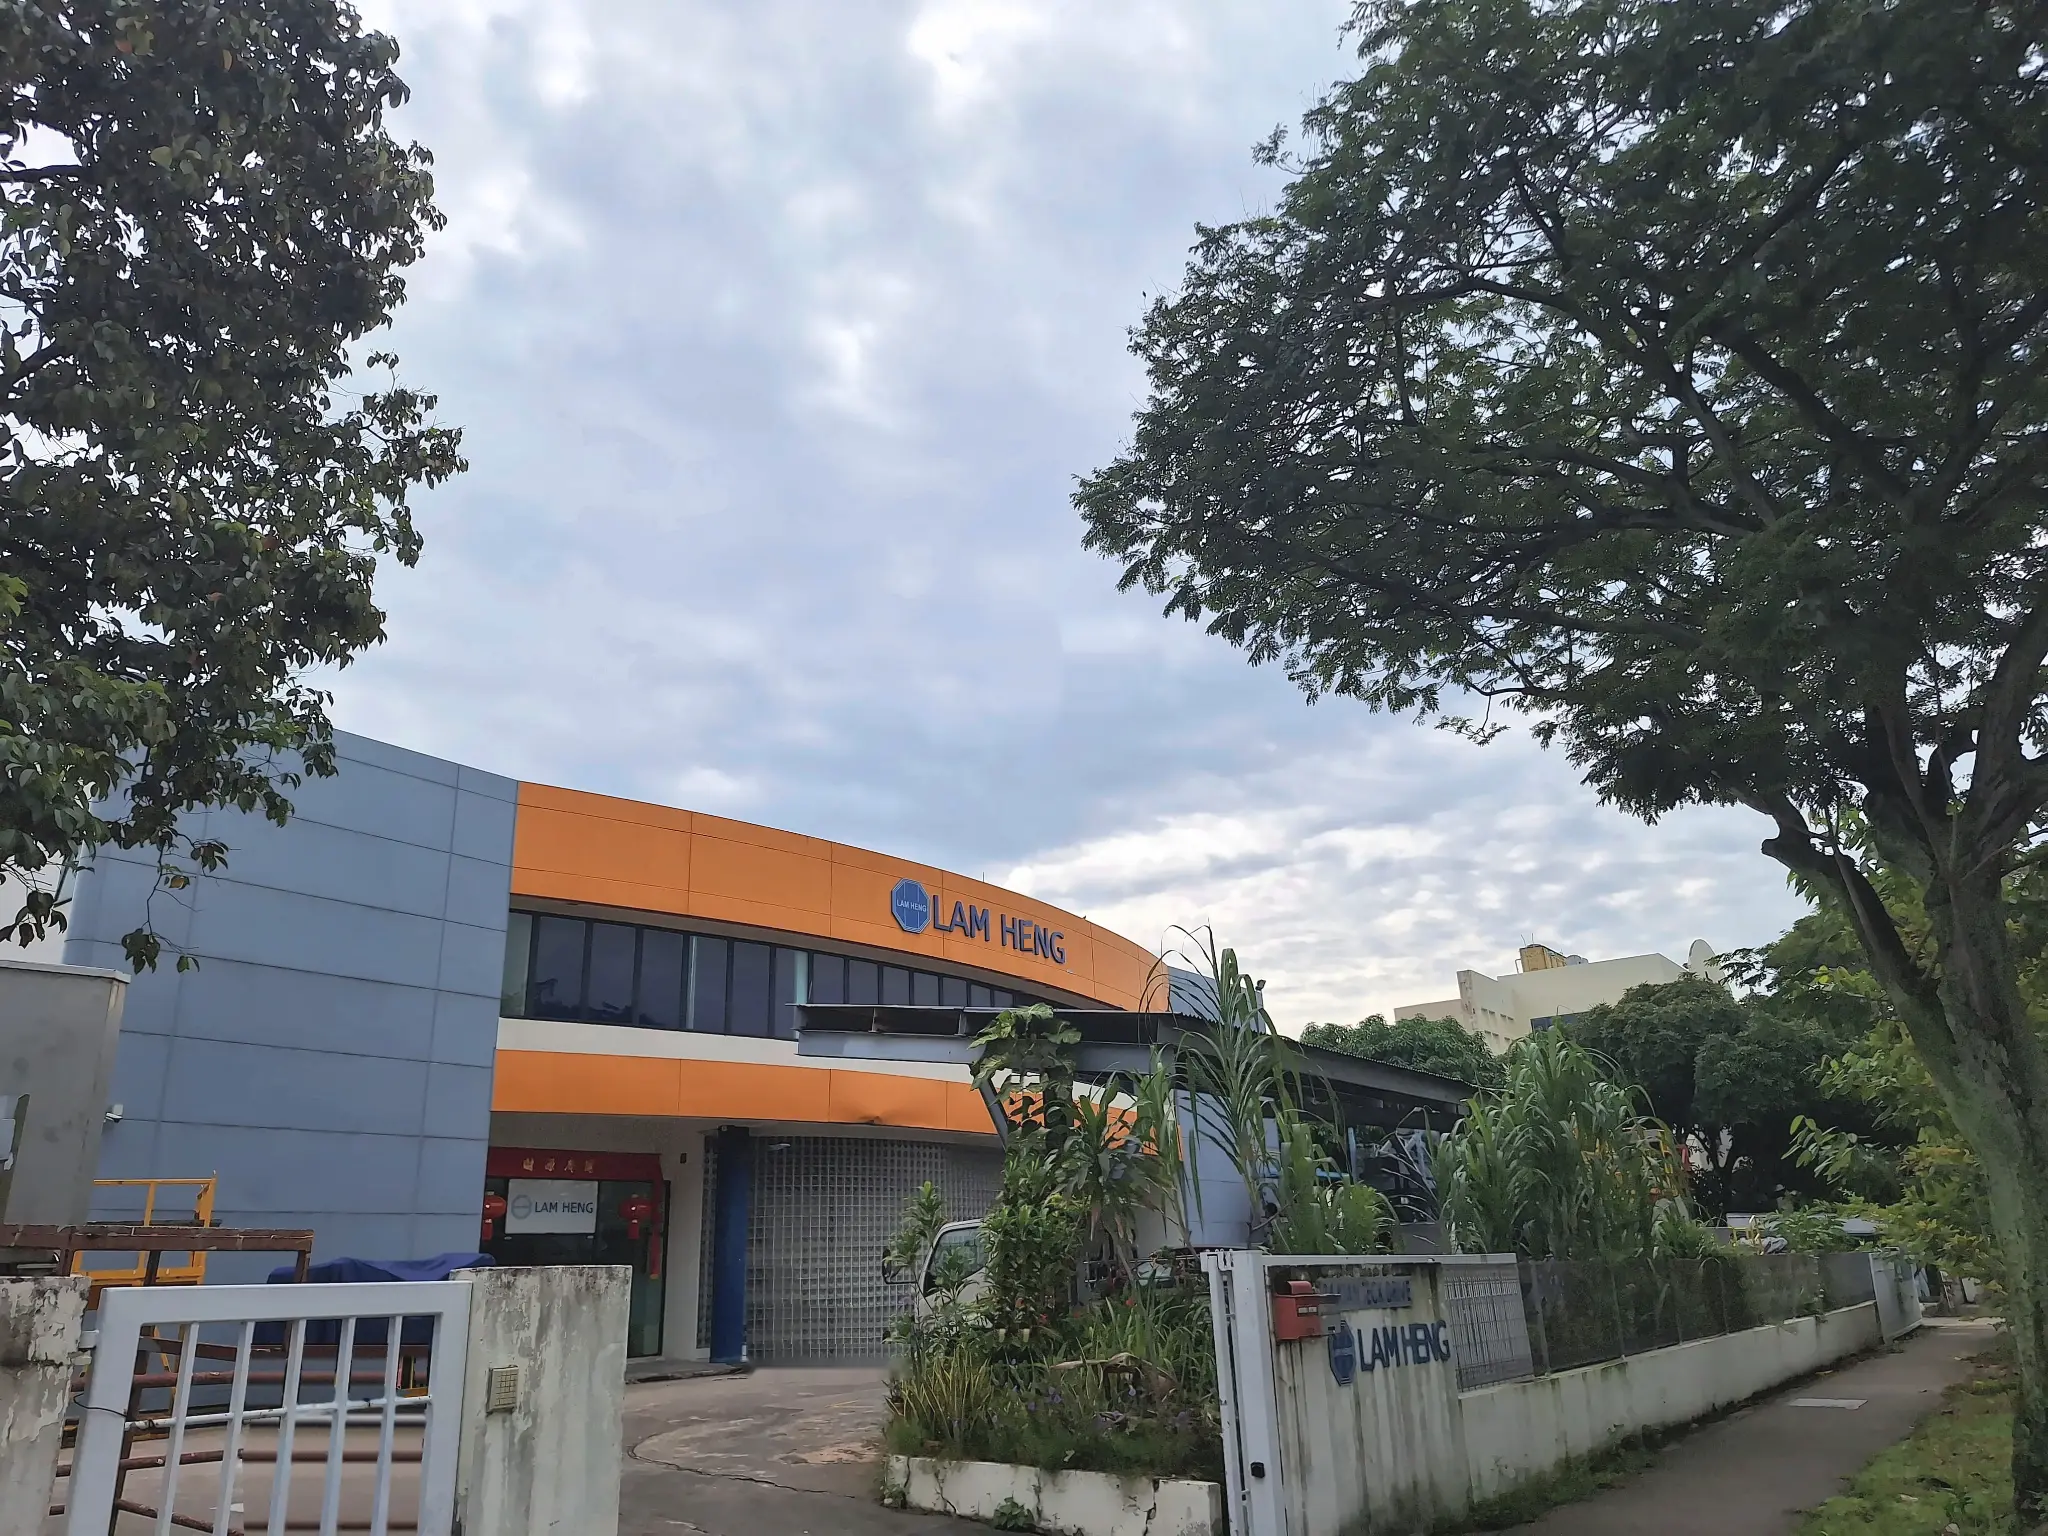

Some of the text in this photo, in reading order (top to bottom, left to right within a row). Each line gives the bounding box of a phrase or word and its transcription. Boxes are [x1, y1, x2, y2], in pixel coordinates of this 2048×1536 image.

[896, 898, 927, 913] LAM HENG
[932, 894, 1066, 964] LAM HENG
[534, 1201, 594, 1214] LAM HENG
[1357, 1319, 1451, 1372] LAM HENG
